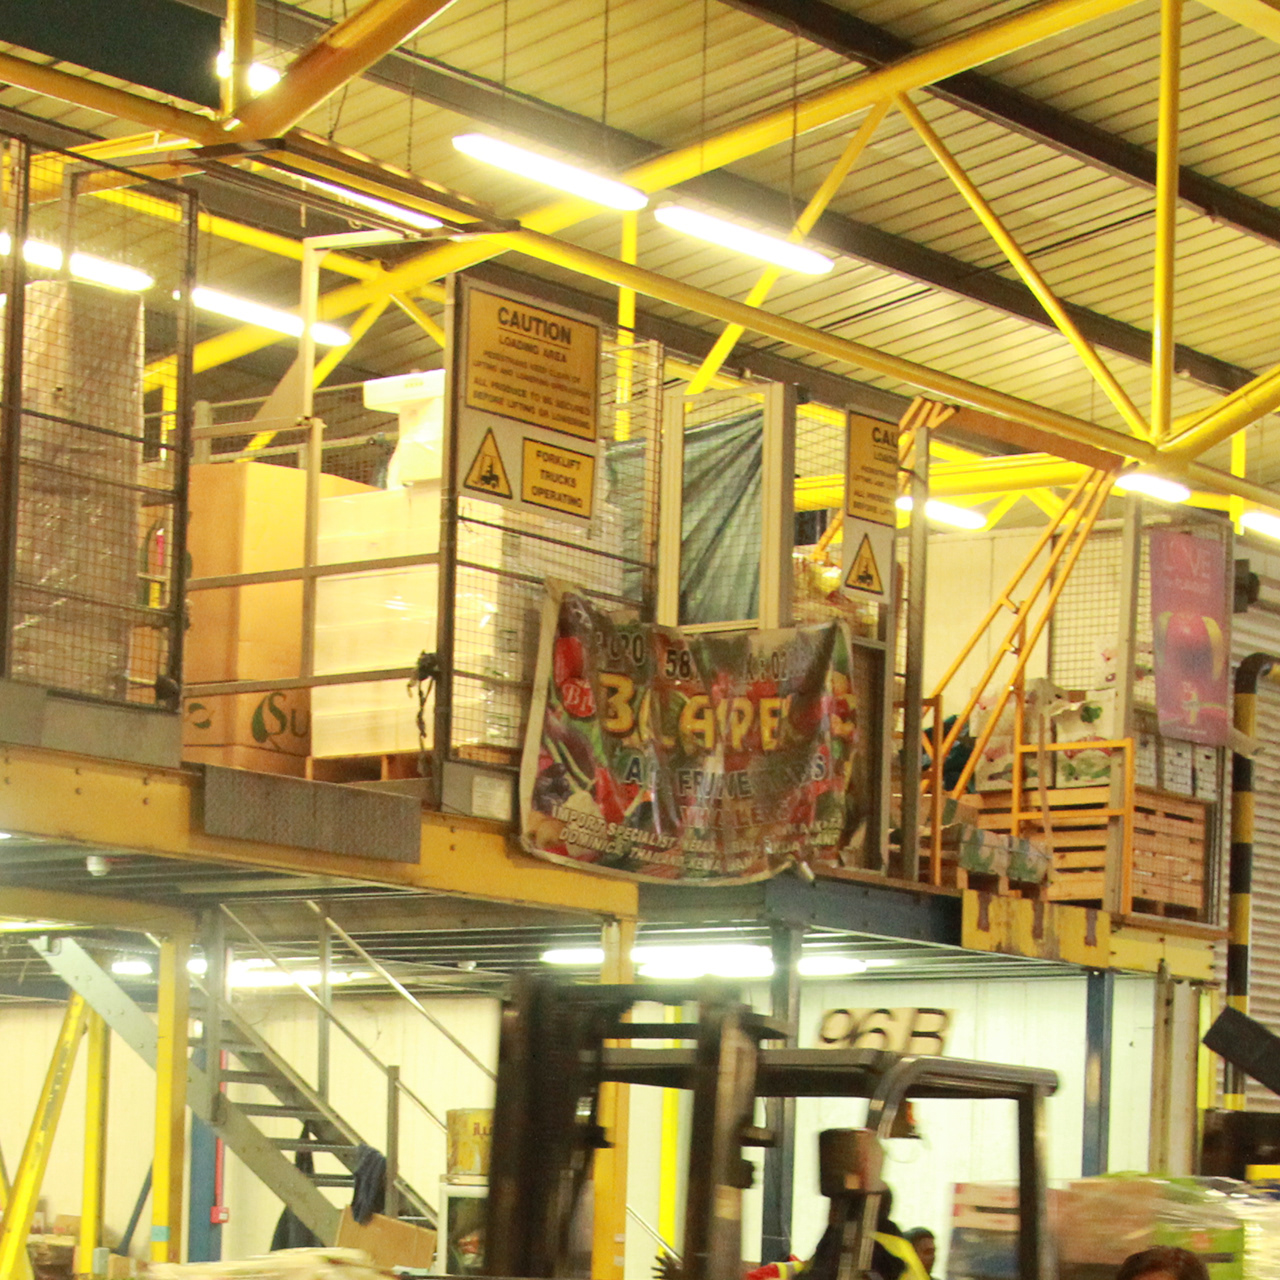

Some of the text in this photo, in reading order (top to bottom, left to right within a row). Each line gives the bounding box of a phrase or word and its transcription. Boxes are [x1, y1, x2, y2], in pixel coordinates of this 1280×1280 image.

[498, 306, 572, 345] CAUTION
[498, 334, 567, 363] LOADING AREA
[536, 450, 581, 470] FORKLIFT
[540, 469, 577, 488] TRUCKS
[531, 485, 582, 508] OPERATING
[551, 805, 607, 834] IMPORT
[558, 828, 628, 858] DOMINIC
